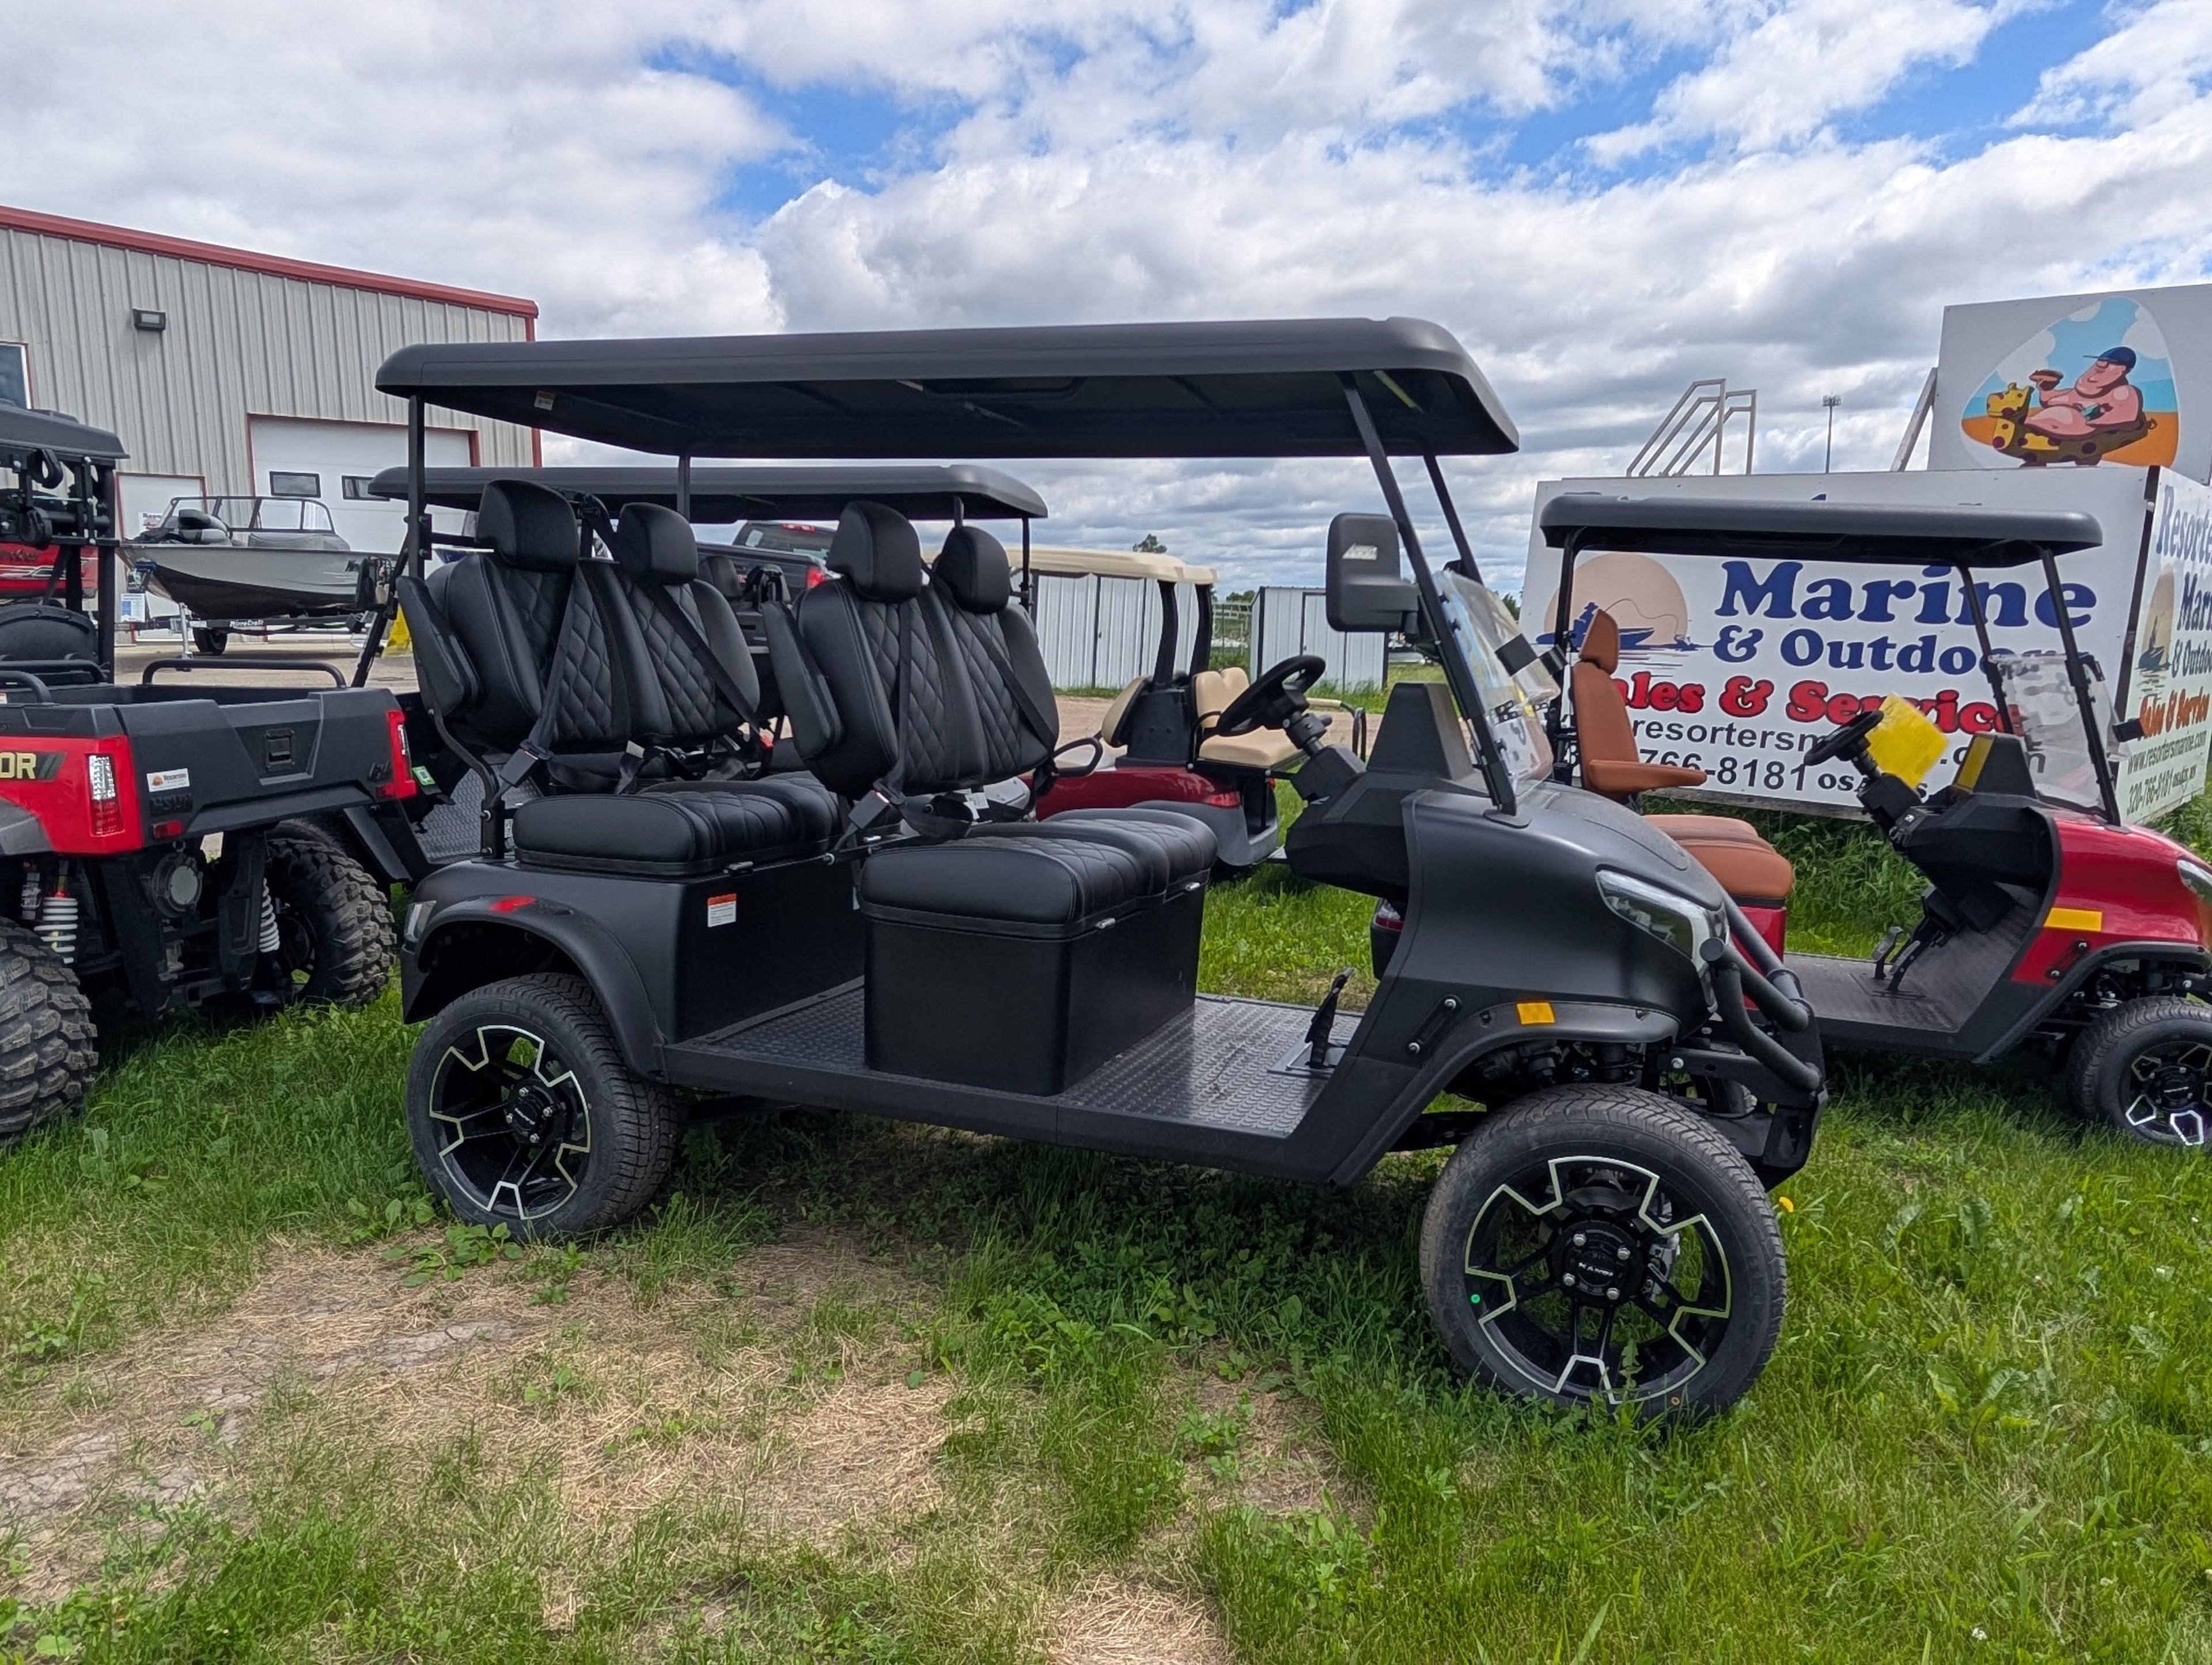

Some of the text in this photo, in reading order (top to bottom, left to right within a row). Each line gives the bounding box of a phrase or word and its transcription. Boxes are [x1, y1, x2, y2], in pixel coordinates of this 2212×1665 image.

[1714, 561, 2097, 628] Marine
[1714, 625, 1763, 663] &
[1719, 675, 1775, 718] &
